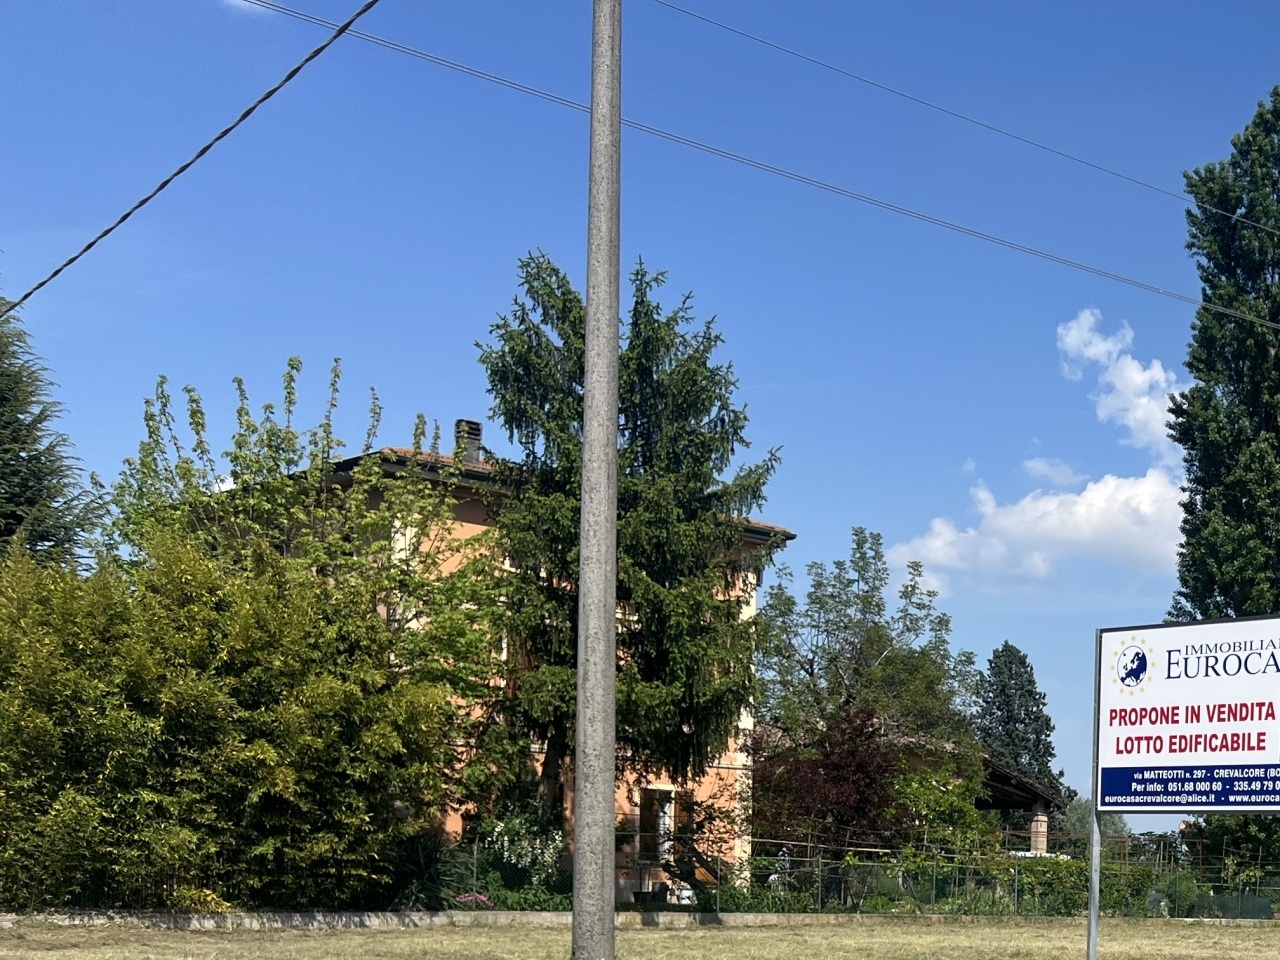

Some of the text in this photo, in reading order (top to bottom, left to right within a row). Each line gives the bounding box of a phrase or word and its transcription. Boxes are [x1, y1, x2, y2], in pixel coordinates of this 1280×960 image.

[1109, 702, 1275, 726] PROPONE IN VENDITA
[1116, 732, 1266, 754] LOTTO EDIFICABILE
[1144, 770, 1184, 779] MATTEOTTI
[1192, 770, 1206, 778] 297
[1214, 768, 1265, 778] CREVALCORE
[1132, 782, 1145, 792] Per
[1146, 782, 1164, 791] info:
[1168, 782, 1194, 792] 051.68
[1196, 782, 1210, 791] 000
[1212, 782, 1222, 791] 60
[1234, 781, 1260, 790] 335.49
[1263, 781, 1273, 790] 79
[1104, 794, 1215, 804] eurocasacrevalcore@alice.it
